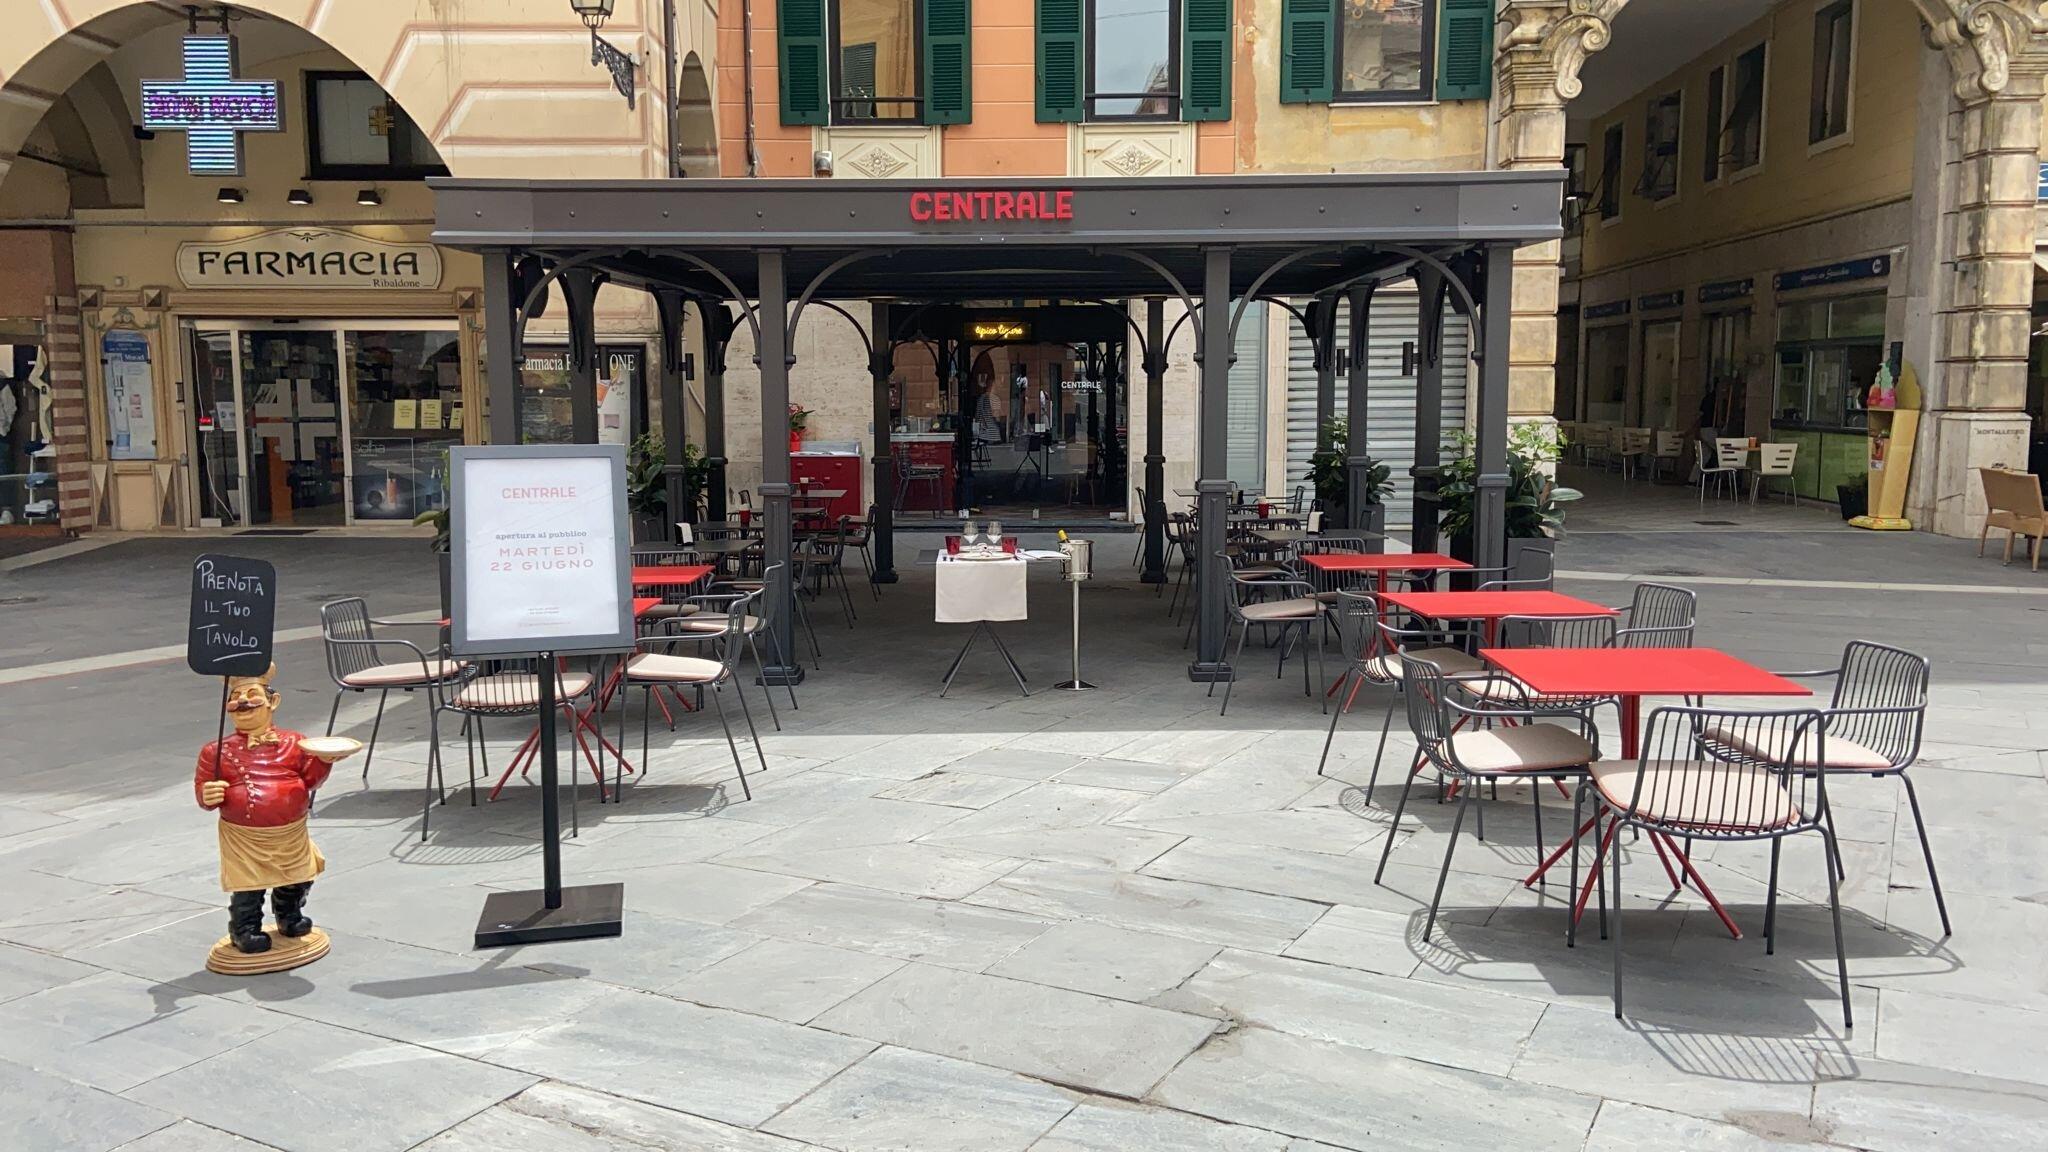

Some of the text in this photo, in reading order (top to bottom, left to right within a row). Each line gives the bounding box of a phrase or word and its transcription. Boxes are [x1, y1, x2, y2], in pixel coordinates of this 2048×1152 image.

[909, 190, 1074, 221] CENTRALE
[197, 251, 420, 278] FARMACIA
[372, 278, 421, 288] Ribaldone
[520, 353, 564, 371] armacia
[1061, 380, 1101, 389] CENTRALE
[502, 486, 577, 499] CENTRALE
[496, 532, 535, 540] apertura
[549, 530, 587, 540] pubblico
[499, 543, 585, 558] MARTEDÌ
[490, 559, 594, 572] 22 GIUGNO
[204, 600, 251, 616] IL TUO
[196, 623, 259, 648] TAVOLO
